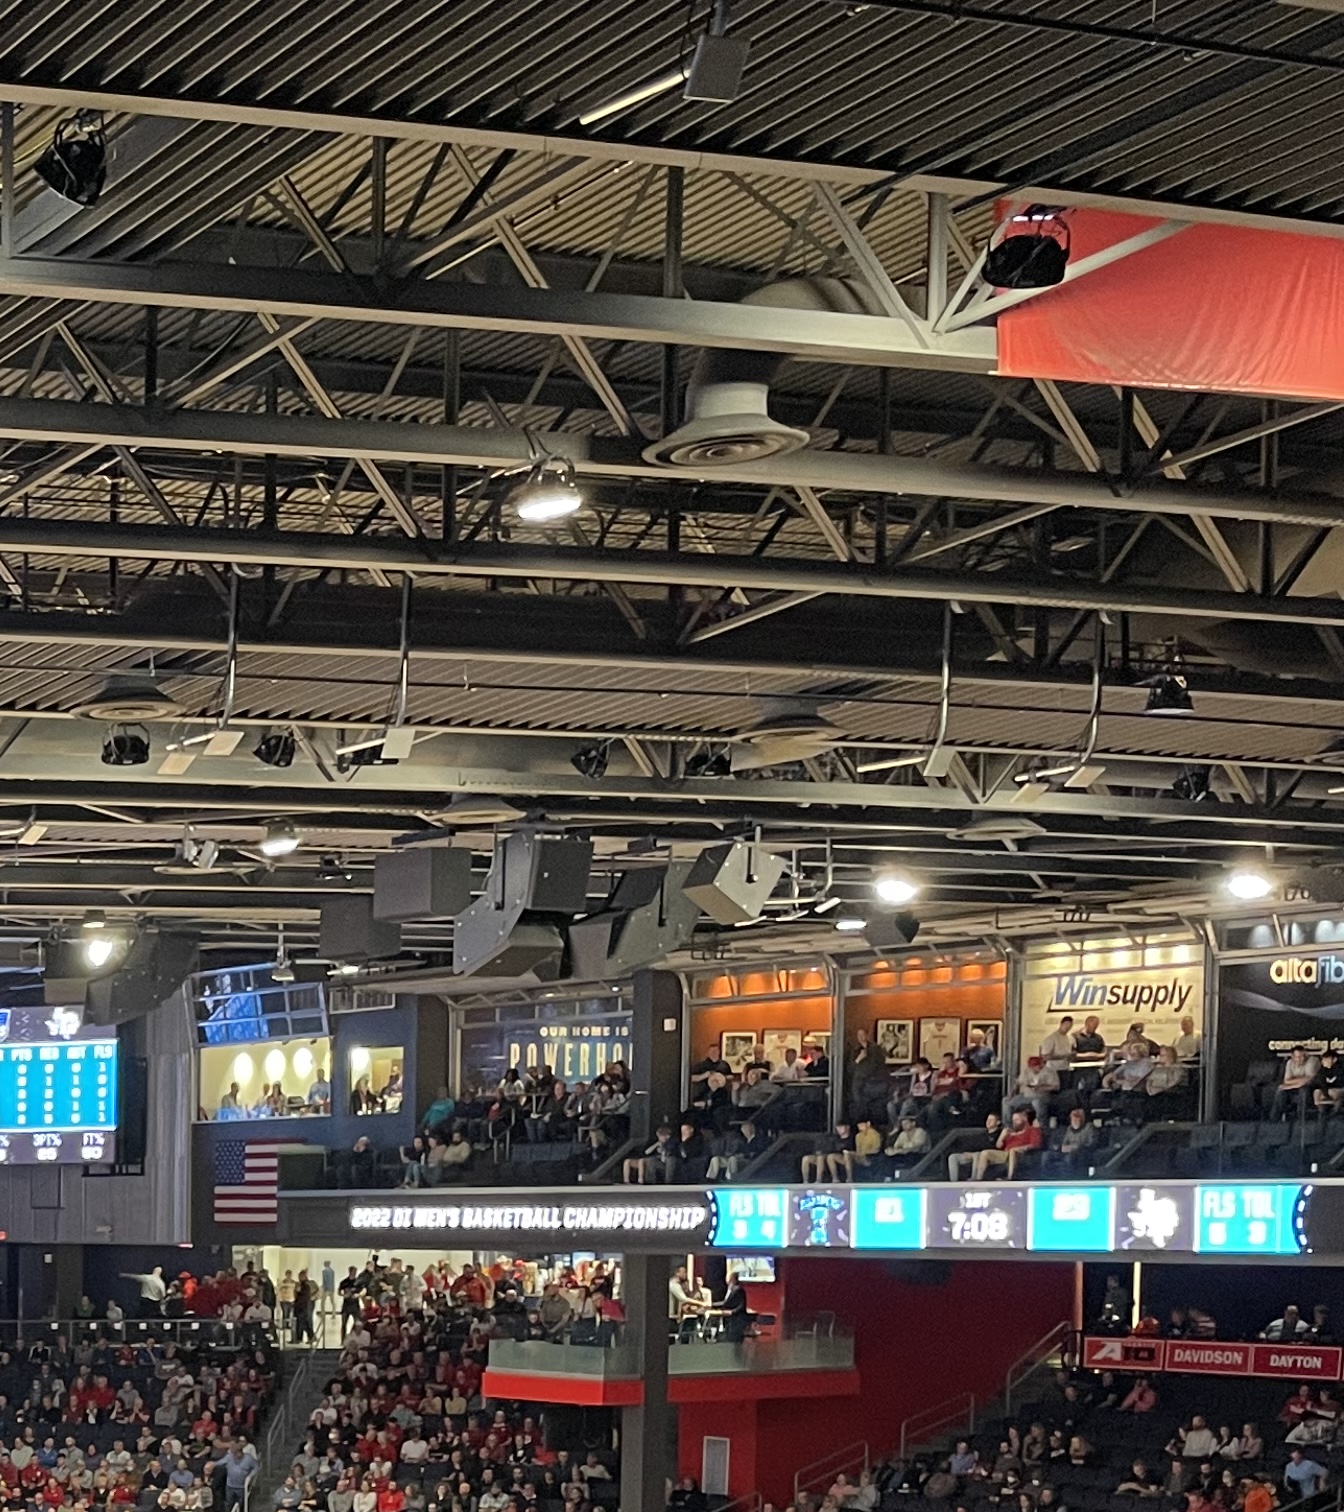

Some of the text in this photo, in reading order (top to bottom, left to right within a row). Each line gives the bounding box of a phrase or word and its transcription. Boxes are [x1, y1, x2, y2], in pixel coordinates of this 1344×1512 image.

[1055, 975, 1193, 1012] Winsupply
[540, 1026, 629, 1037] OUR HOME IS
[963, 1192, 992, 1209] 1ST
[1203, 1191, 1275, 1218] FLS TOL
[351, 1207, 391, 1228] 2022
[414, 1207, 460, 1228] MEN'S
[462, 1207, 562, 1229] BASKETBALL
[563, 1206, 706, 1230] CHAMPIONSHIP
[947, 1213, 1008, 1240] 7:08
[1174, 1349, 1244, 1365] DAVIDSON
[1270, 1354, 1322, 1369] DAYTON
